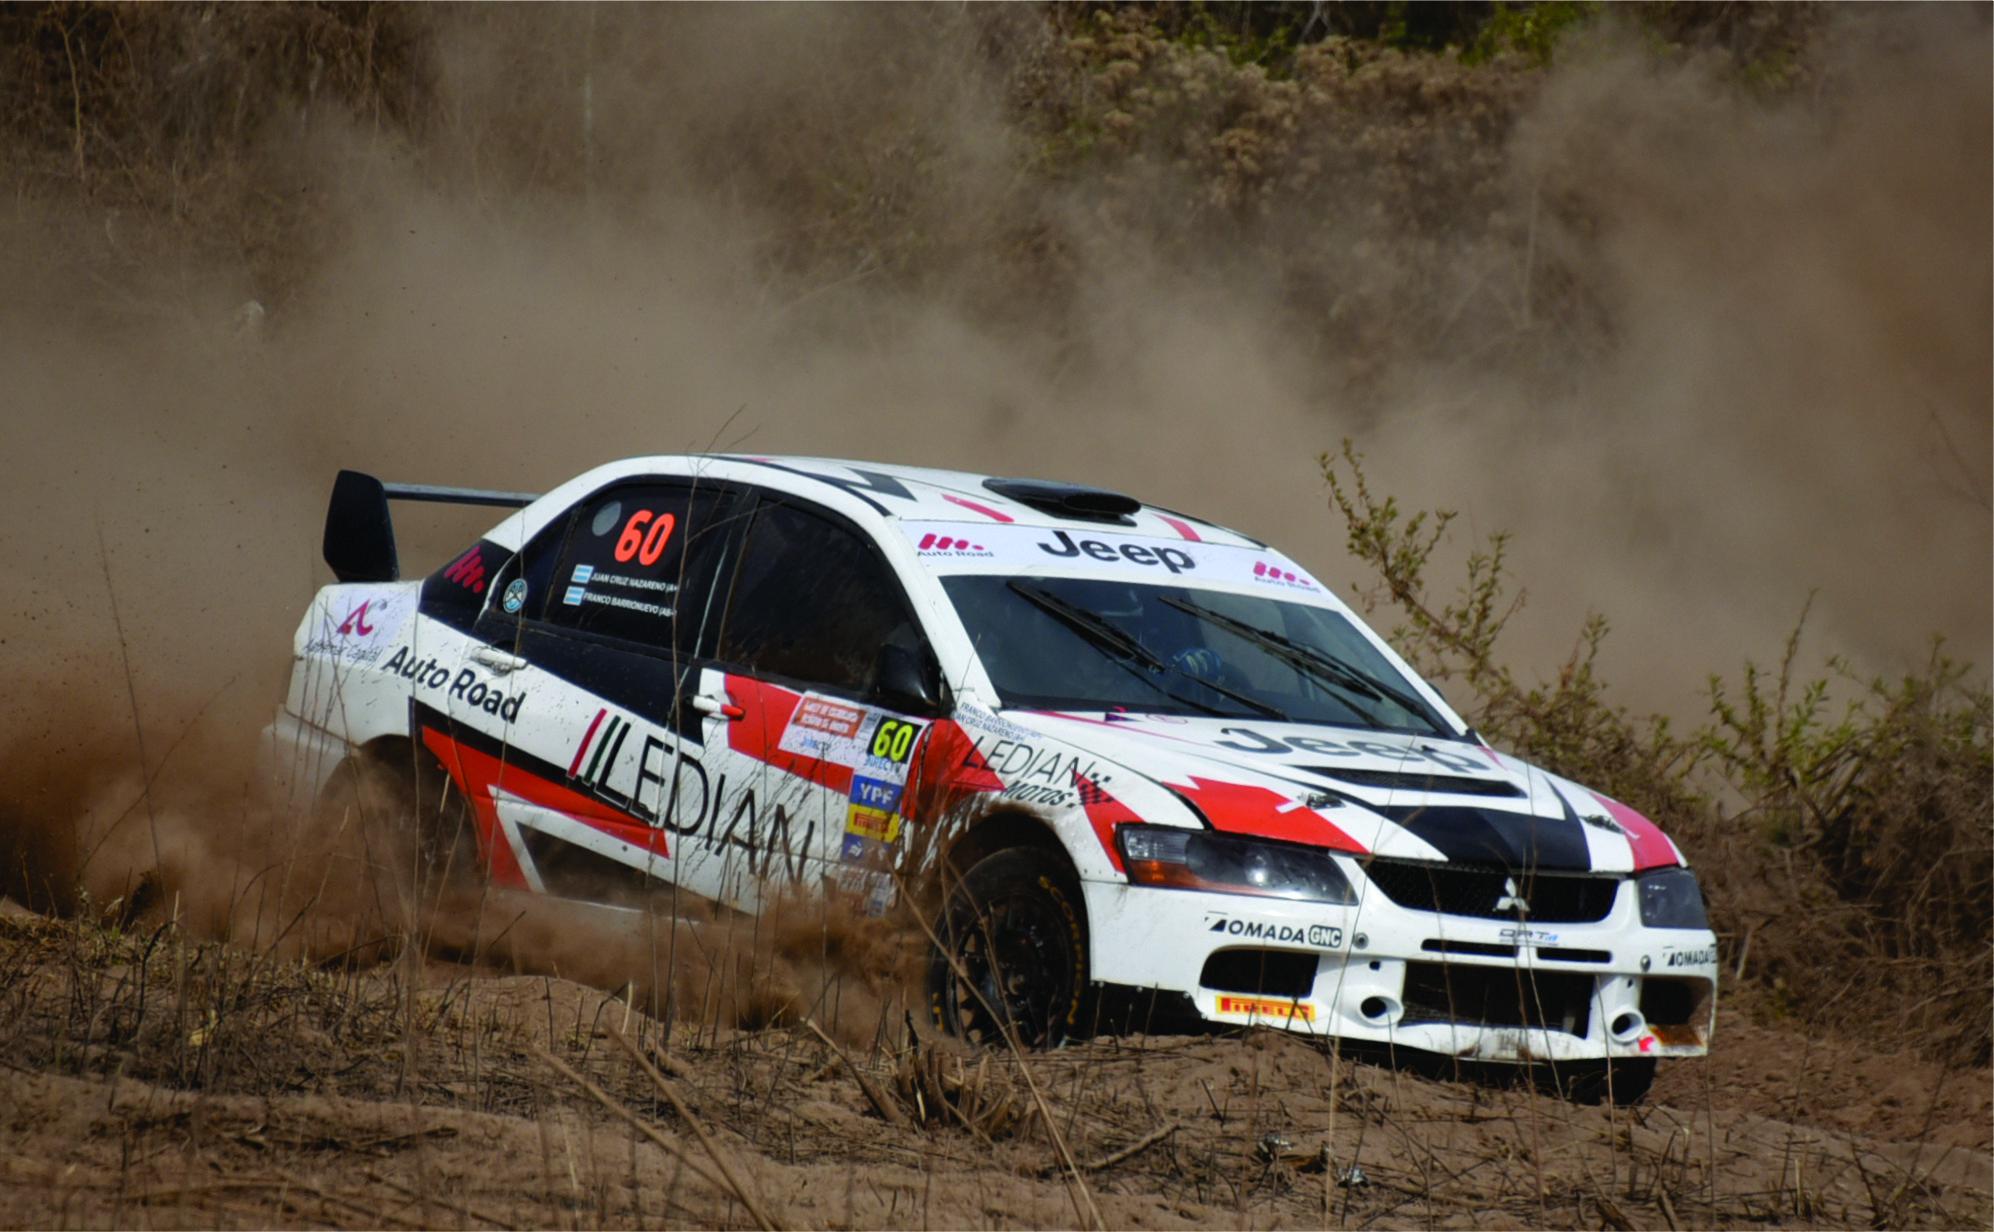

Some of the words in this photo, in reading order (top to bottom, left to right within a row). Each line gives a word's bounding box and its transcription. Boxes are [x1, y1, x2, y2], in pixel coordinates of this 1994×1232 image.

[614, 509, 675, 566] 60
[1037, 530, 1195, 574] Jeep
[380, 646, 449, 689] Auto
[449, 668, 527, 724] Road
[873, 720, 914, 762] 60
[962, 735, 1096, 788] LEDIAN
[1213, 728, 1492, 774] Jeep
[596, 721, 815, 884] LEDIAN
[860, 782, 894, 805] YPF
[1001, 780, 1070, 805] MOTOS
[1309, 926, 1342, 948] GNC
